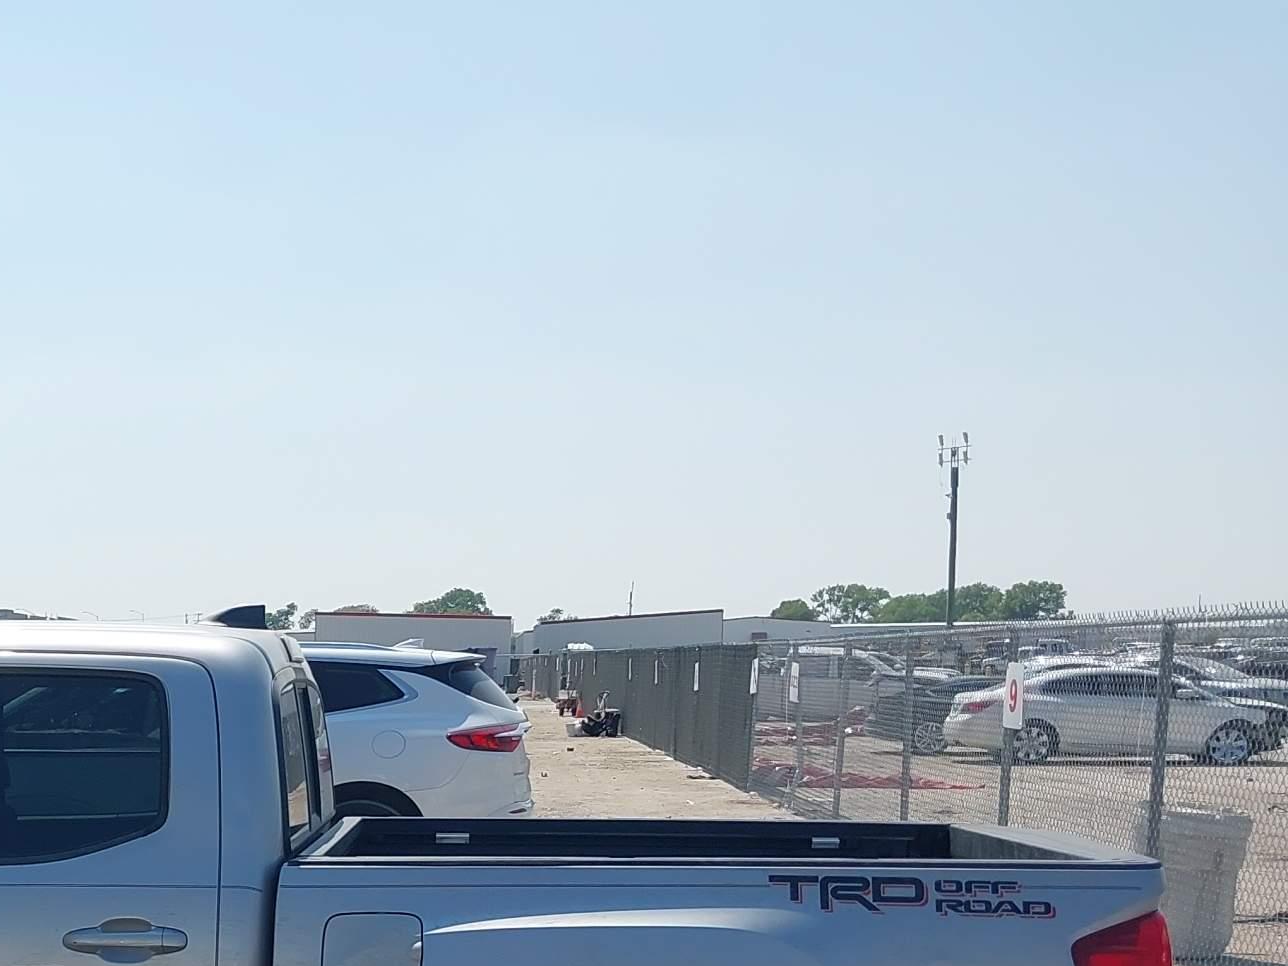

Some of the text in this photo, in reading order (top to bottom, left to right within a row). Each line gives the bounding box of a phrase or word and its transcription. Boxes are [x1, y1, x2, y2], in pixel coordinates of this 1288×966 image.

[1009, 679, 1017, 713] 9
[768, 875, 929, 914] TRD
[934, 879, 1022, 897] OFF
[935, 898, 1056, 919] ROAD
